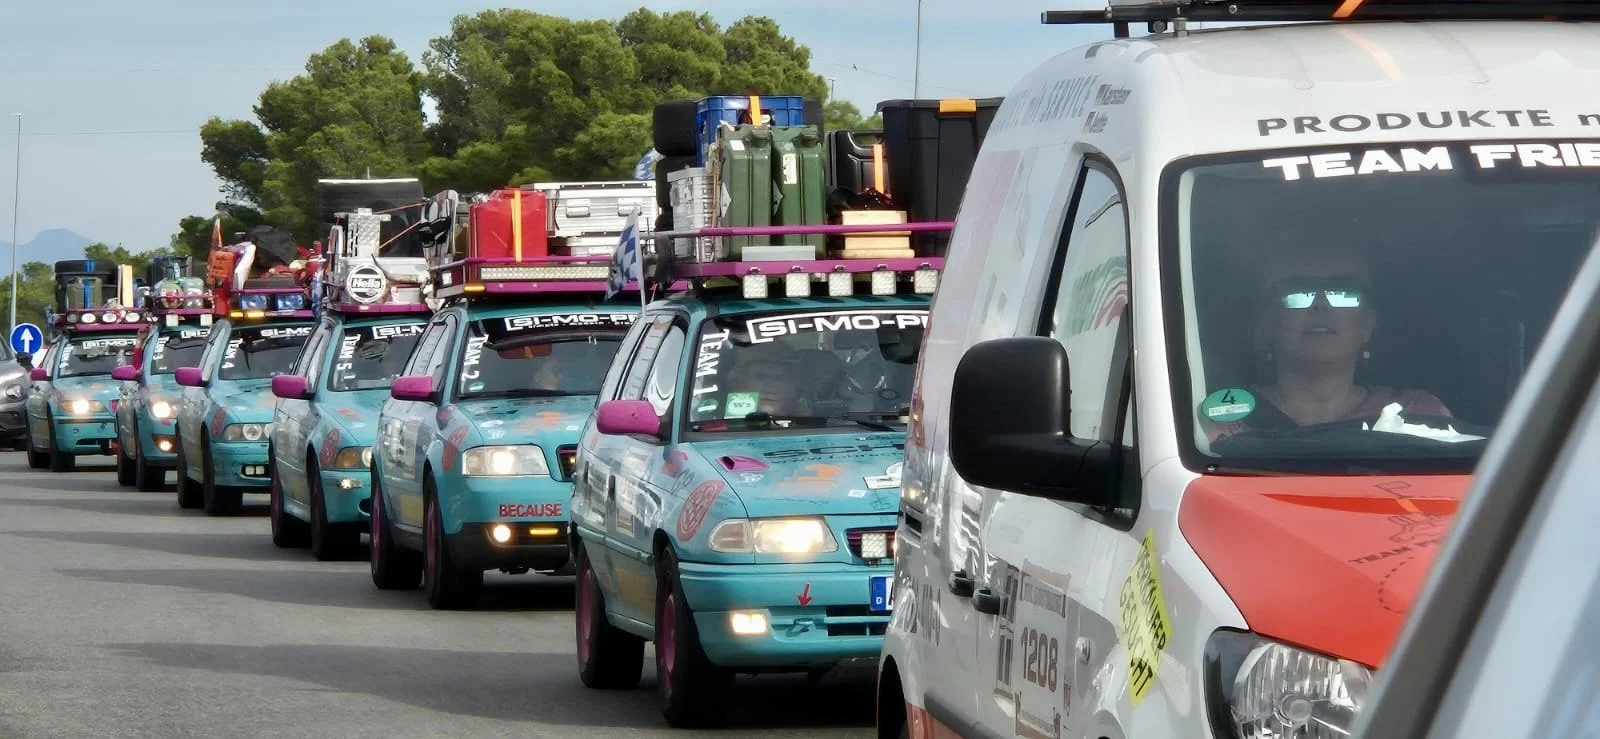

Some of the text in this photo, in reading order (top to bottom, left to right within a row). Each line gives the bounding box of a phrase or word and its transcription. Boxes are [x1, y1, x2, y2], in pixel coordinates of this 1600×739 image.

[1258, 110, 1554, 136] PRODUKTE
[1263, 147, 1453, 181] TEAM
[759, 315, 930, 337] SI-MO-P
[337, 334, 361, 370] TEAM 5
[462, 334, 488, 380] TEAM 2
[693, 329, 730, 396] TEAM 1
[1221, 390, 1236, 404] 4
[500, 504, 562, 517] BECAUSE
[1021, 626, 1059, 693] 1208
